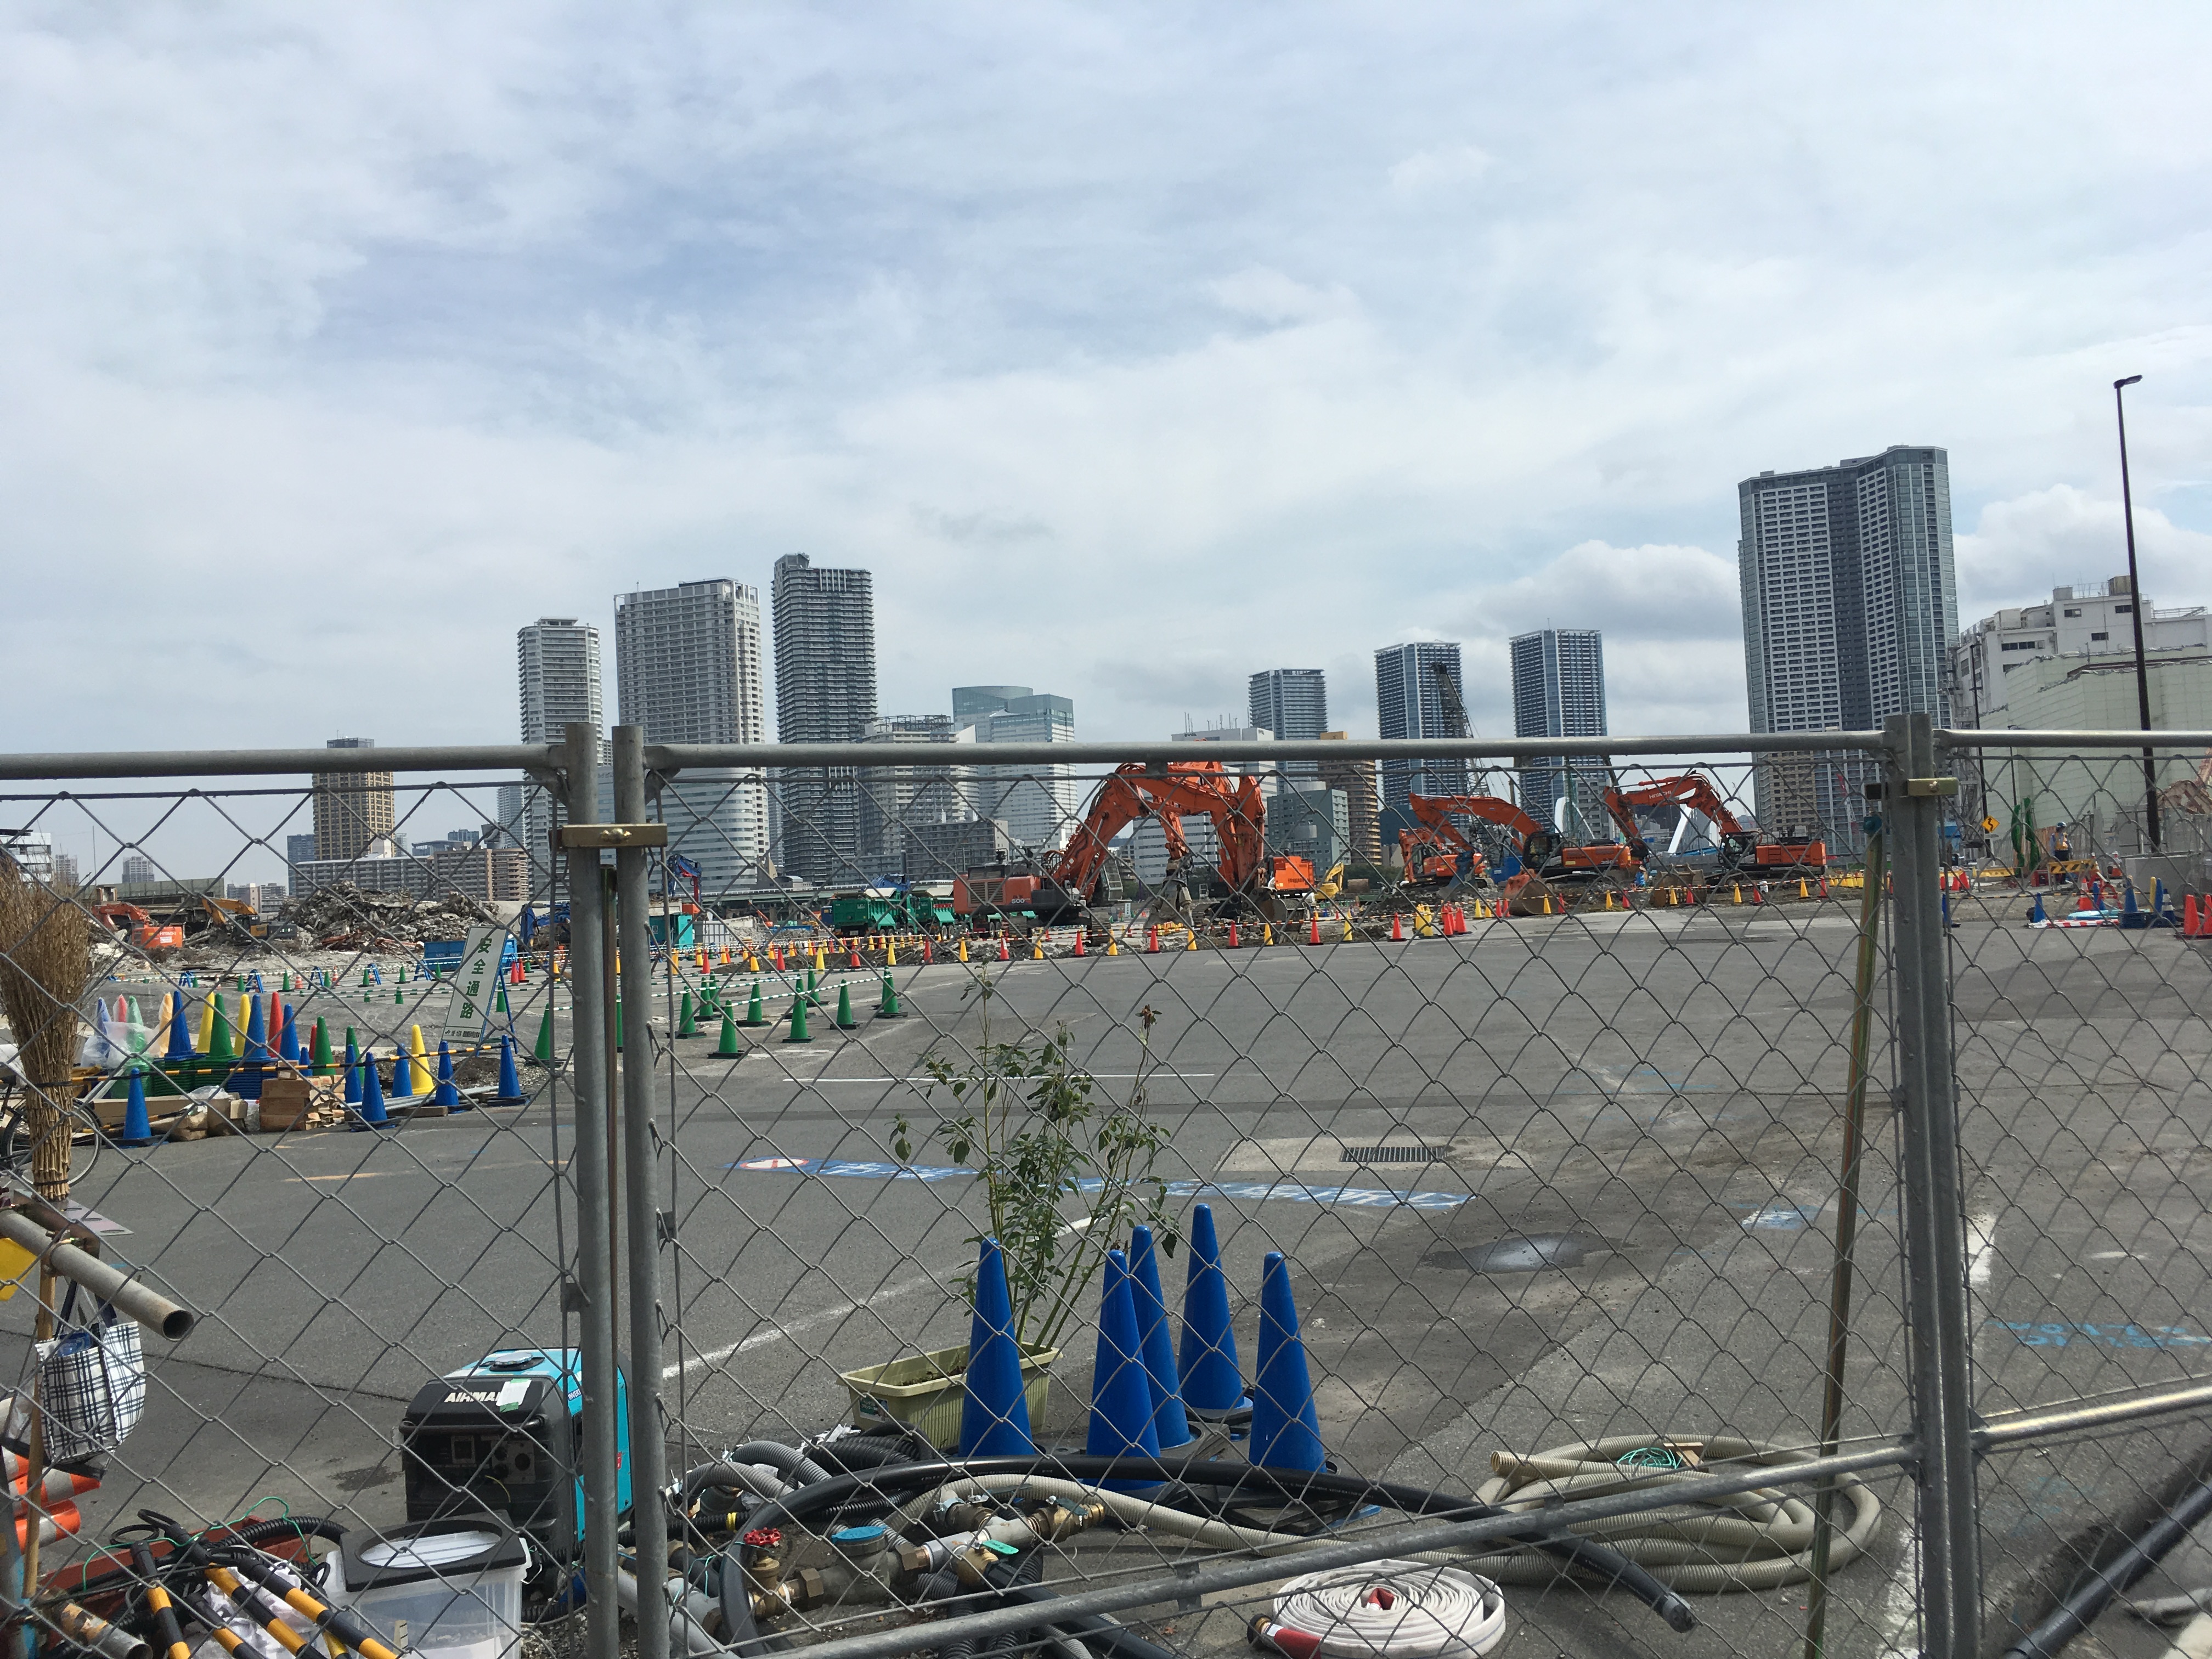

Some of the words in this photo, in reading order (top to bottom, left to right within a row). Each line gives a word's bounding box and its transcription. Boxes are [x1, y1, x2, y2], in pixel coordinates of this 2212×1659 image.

[1649, 791, 1672, 799] HITACHI
[459, 937, 493, 1020] 安全通路
